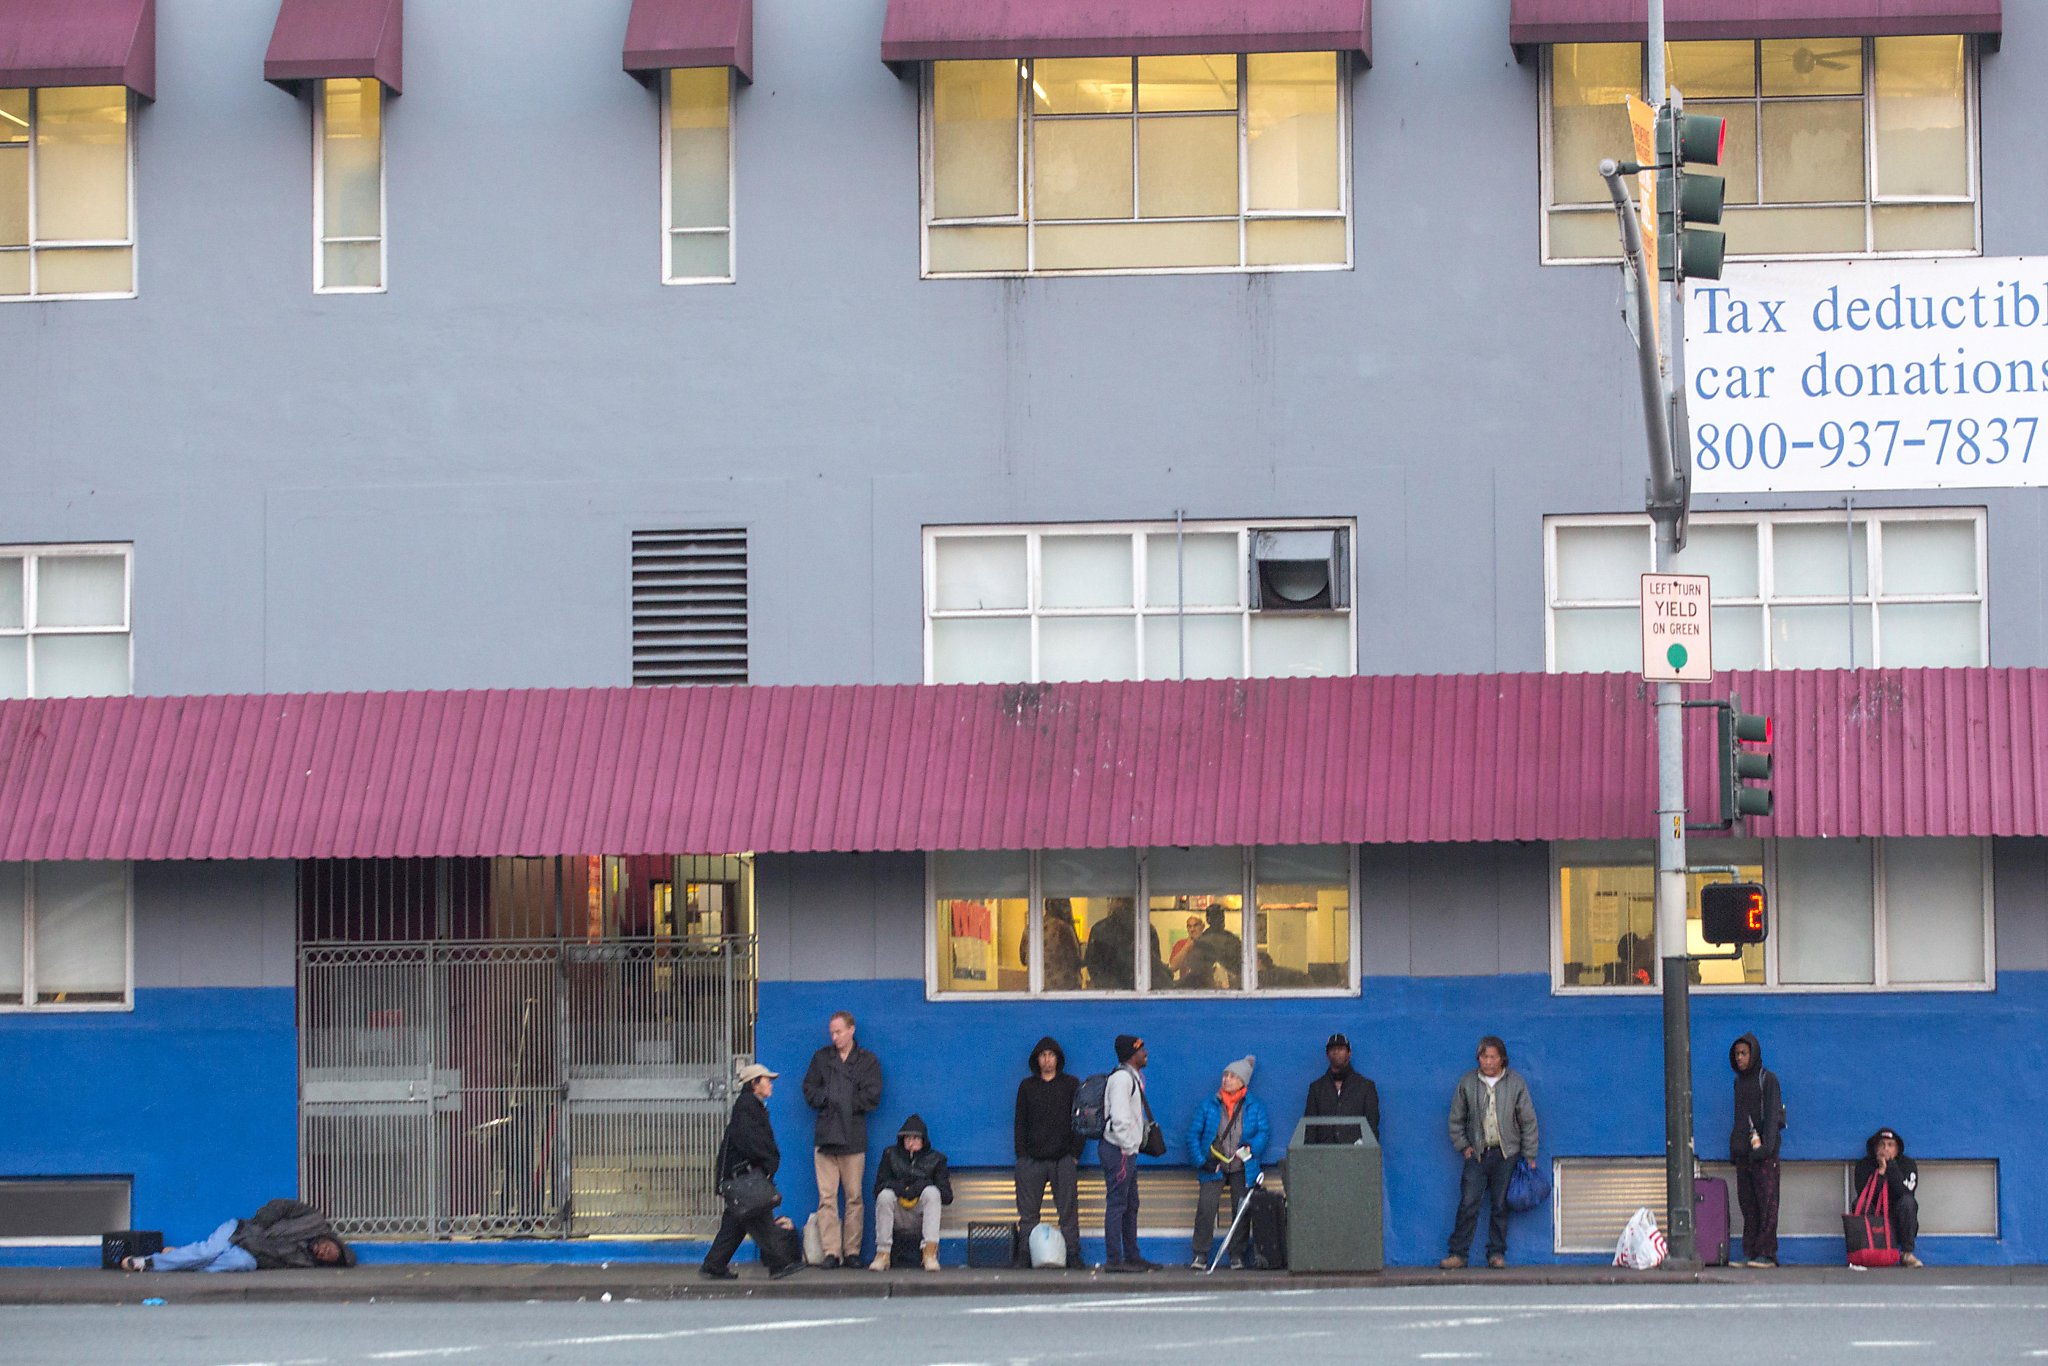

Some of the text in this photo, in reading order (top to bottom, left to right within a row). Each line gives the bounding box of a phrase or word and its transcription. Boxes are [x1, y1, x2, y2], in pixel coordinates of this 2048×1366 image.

[1694, 286, 1787, 334] Tax
[1695, 364, 1776, 401] car
[1696, 416, 2039, 471] 800-937-7837
[1649, 582, 1701, 596] LEFT TURN
[1655, 600, 1698, 617] YIELD
[1652, 622, 1700, 636] ON GREEN
[1747, 893, 1763, 930] 2
